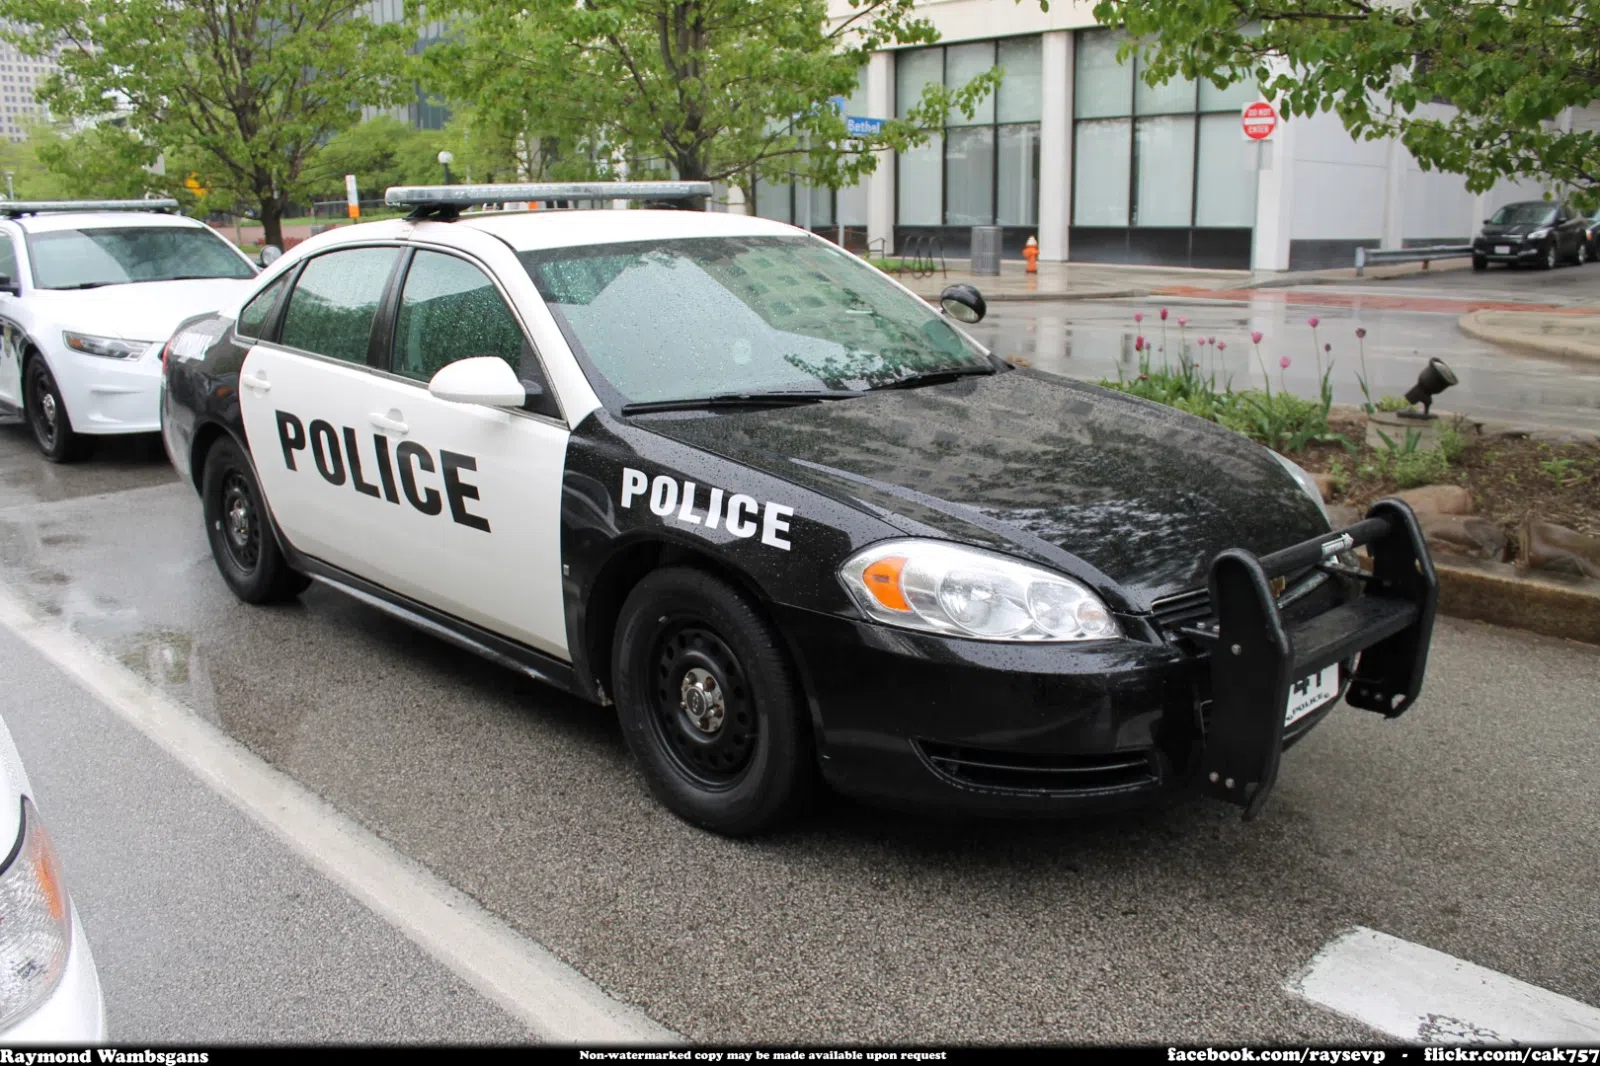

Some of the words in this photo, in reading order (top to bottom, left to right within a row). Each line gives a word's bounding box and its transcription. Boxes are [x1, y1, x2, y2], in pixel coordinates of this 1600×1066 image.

[847, 118, 881, 134] Bethel
[1258, 107, 1272, 117] NOT
[275, 410, 491, 533] POLICE
[621, 467, 793, 551] POLICE
